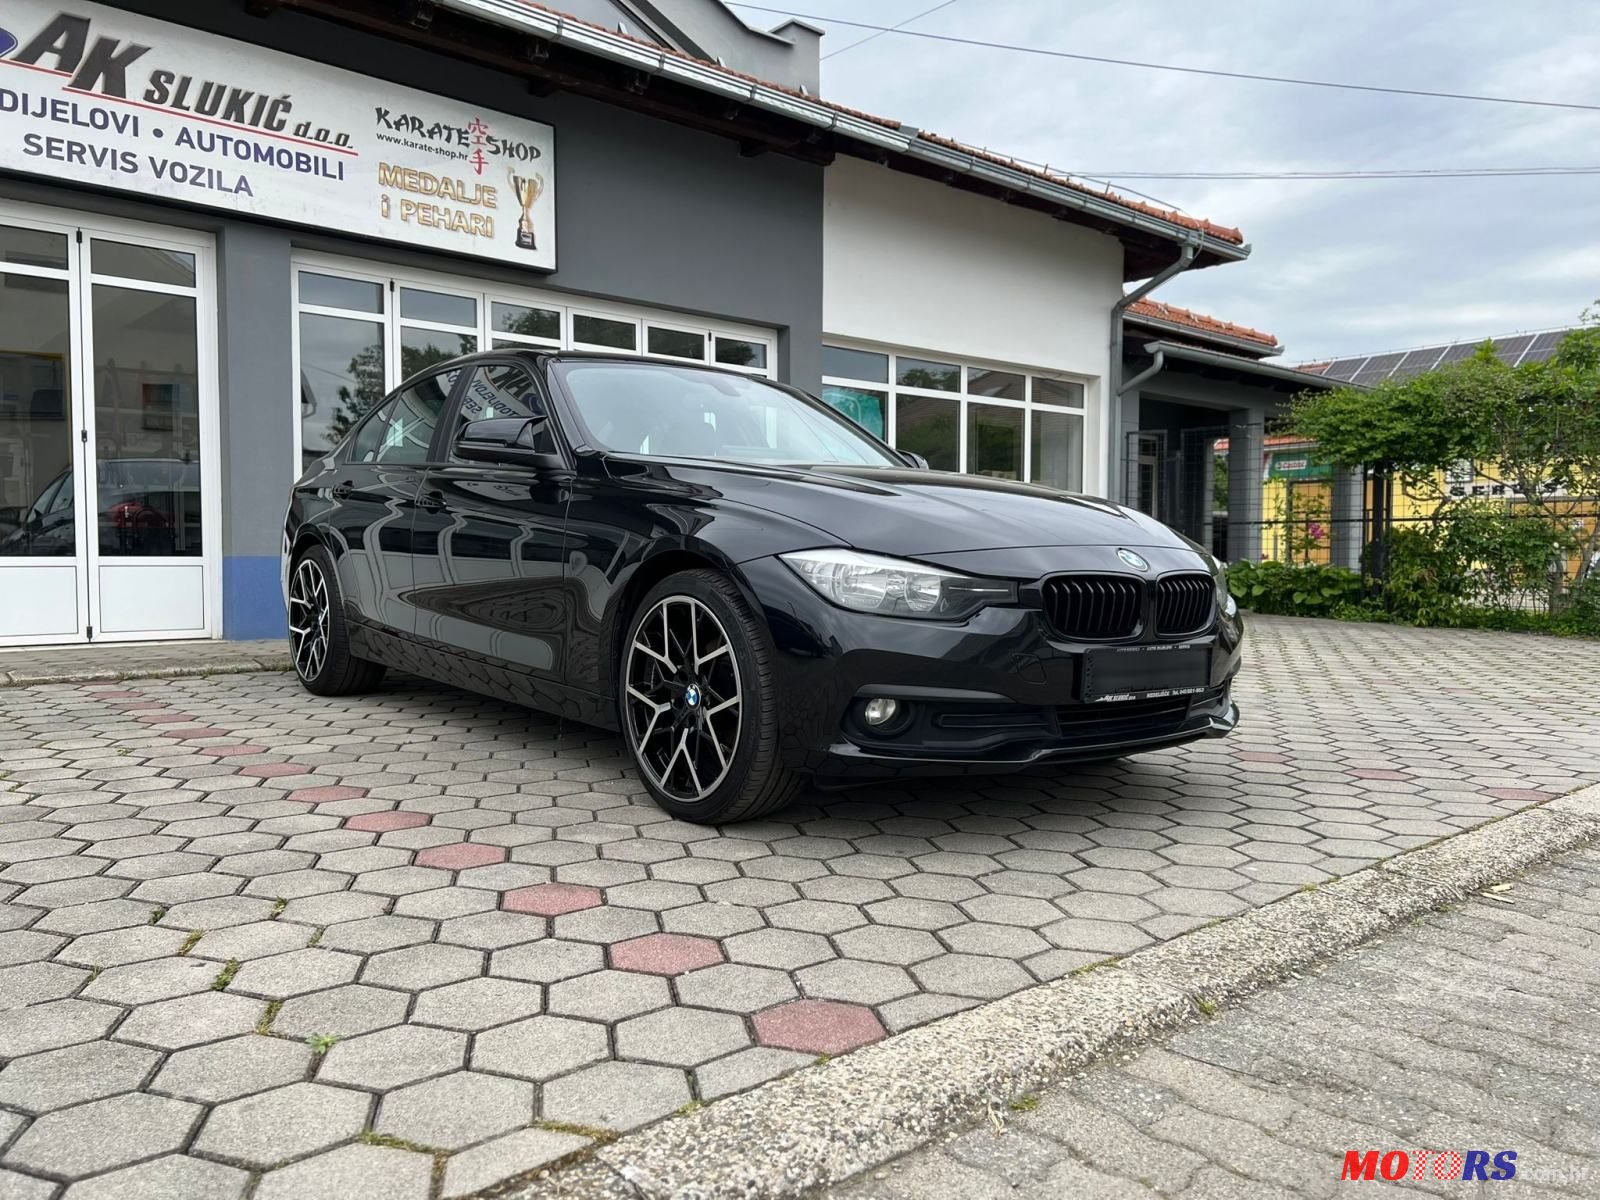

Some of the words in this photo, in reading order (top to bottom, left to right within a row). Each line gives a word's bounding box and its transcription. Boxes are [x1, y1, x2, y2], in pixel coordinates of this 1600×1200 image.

[11, 13, 151, 98] AK
[143, 70, 292, 132] SLUKIĆ
[0, 89, 139, 137] DIJELOVI
[175, 127, 344, 181] AUTOMOBILI
[375, 106, 470, 148] KARATE
[486, 135, 541, 162] SHOP
[376, 132, 468, 160] www.karate-shop.hr
[23, 133, 138, 174] SERVIS
[149, 156, 253, 196] VOZILA
[378, 161, 496, 208] MEDALJE
[381, 194, 390, 219] i
[400, 199, 494, 238] PEHARI
